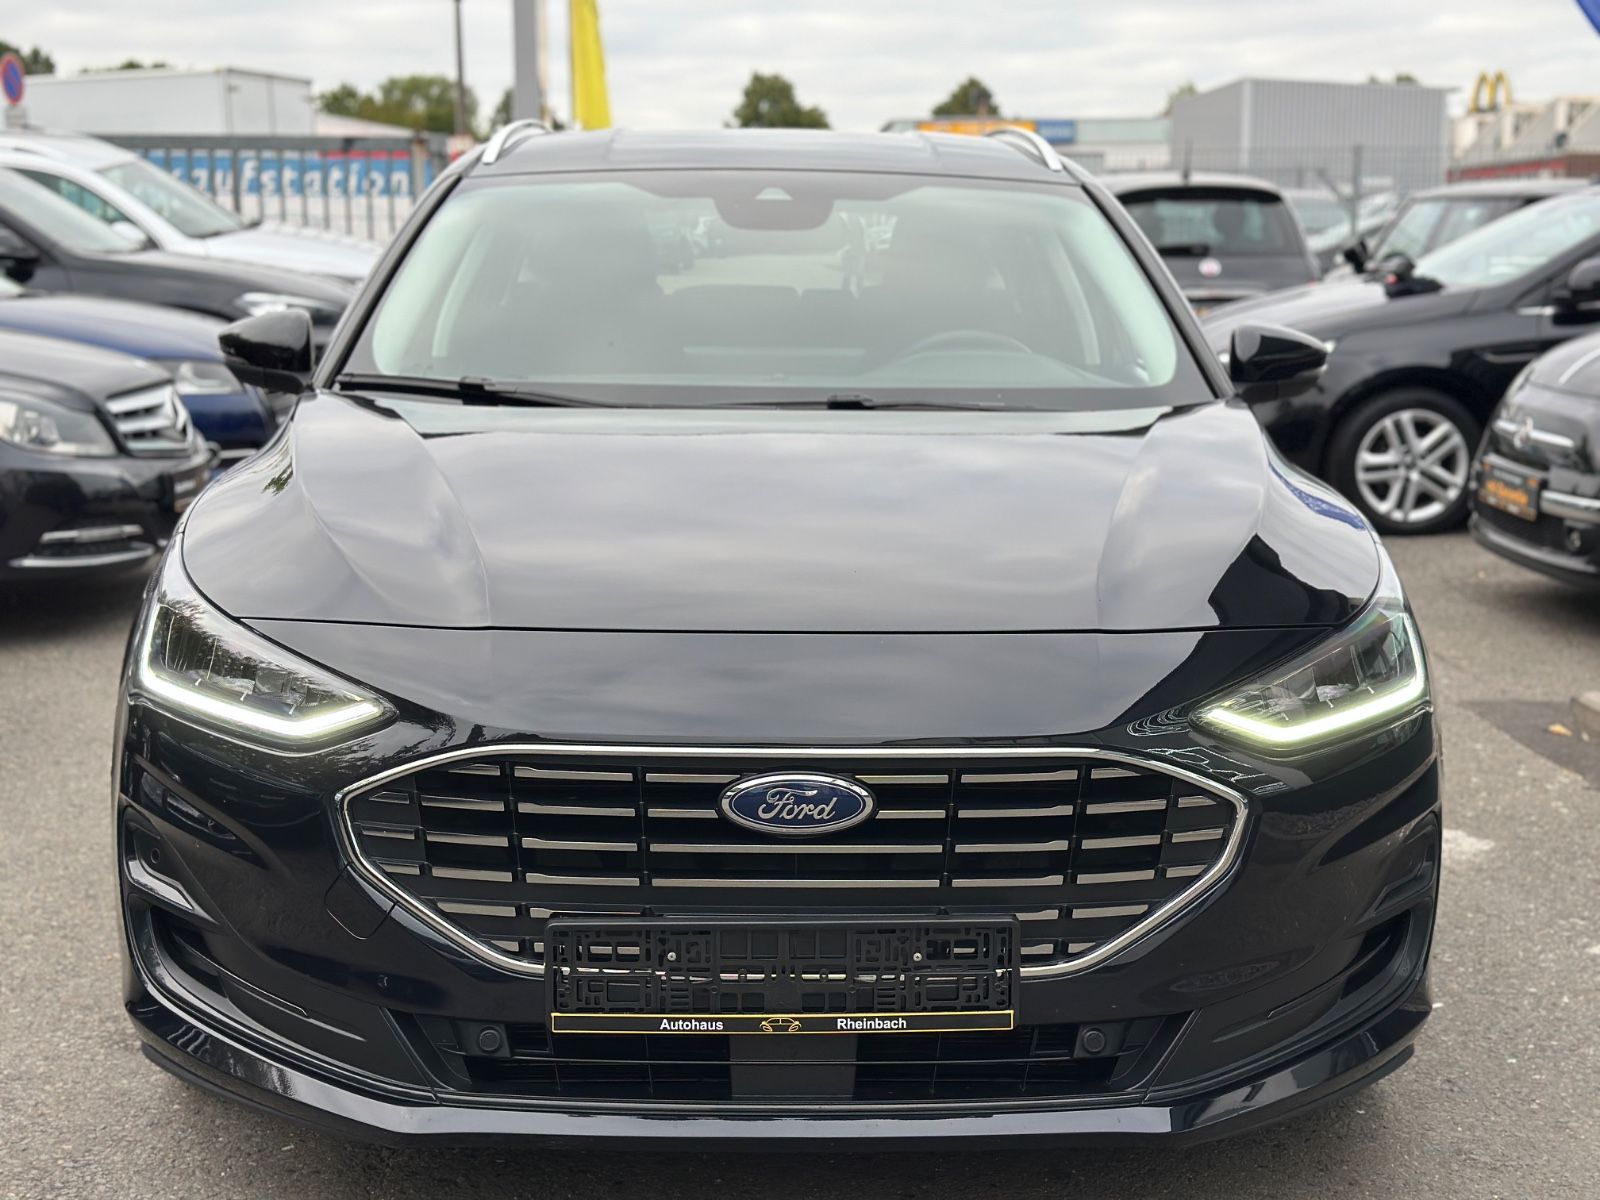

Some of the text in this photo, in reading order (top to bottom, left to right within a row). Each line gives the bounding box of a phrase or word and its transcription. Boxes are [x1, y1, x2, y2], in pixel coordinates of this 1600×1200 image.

[757, 787, 838, 820] Ford
[659, 1017, 907, 1031] Autohaus Rheinbach
